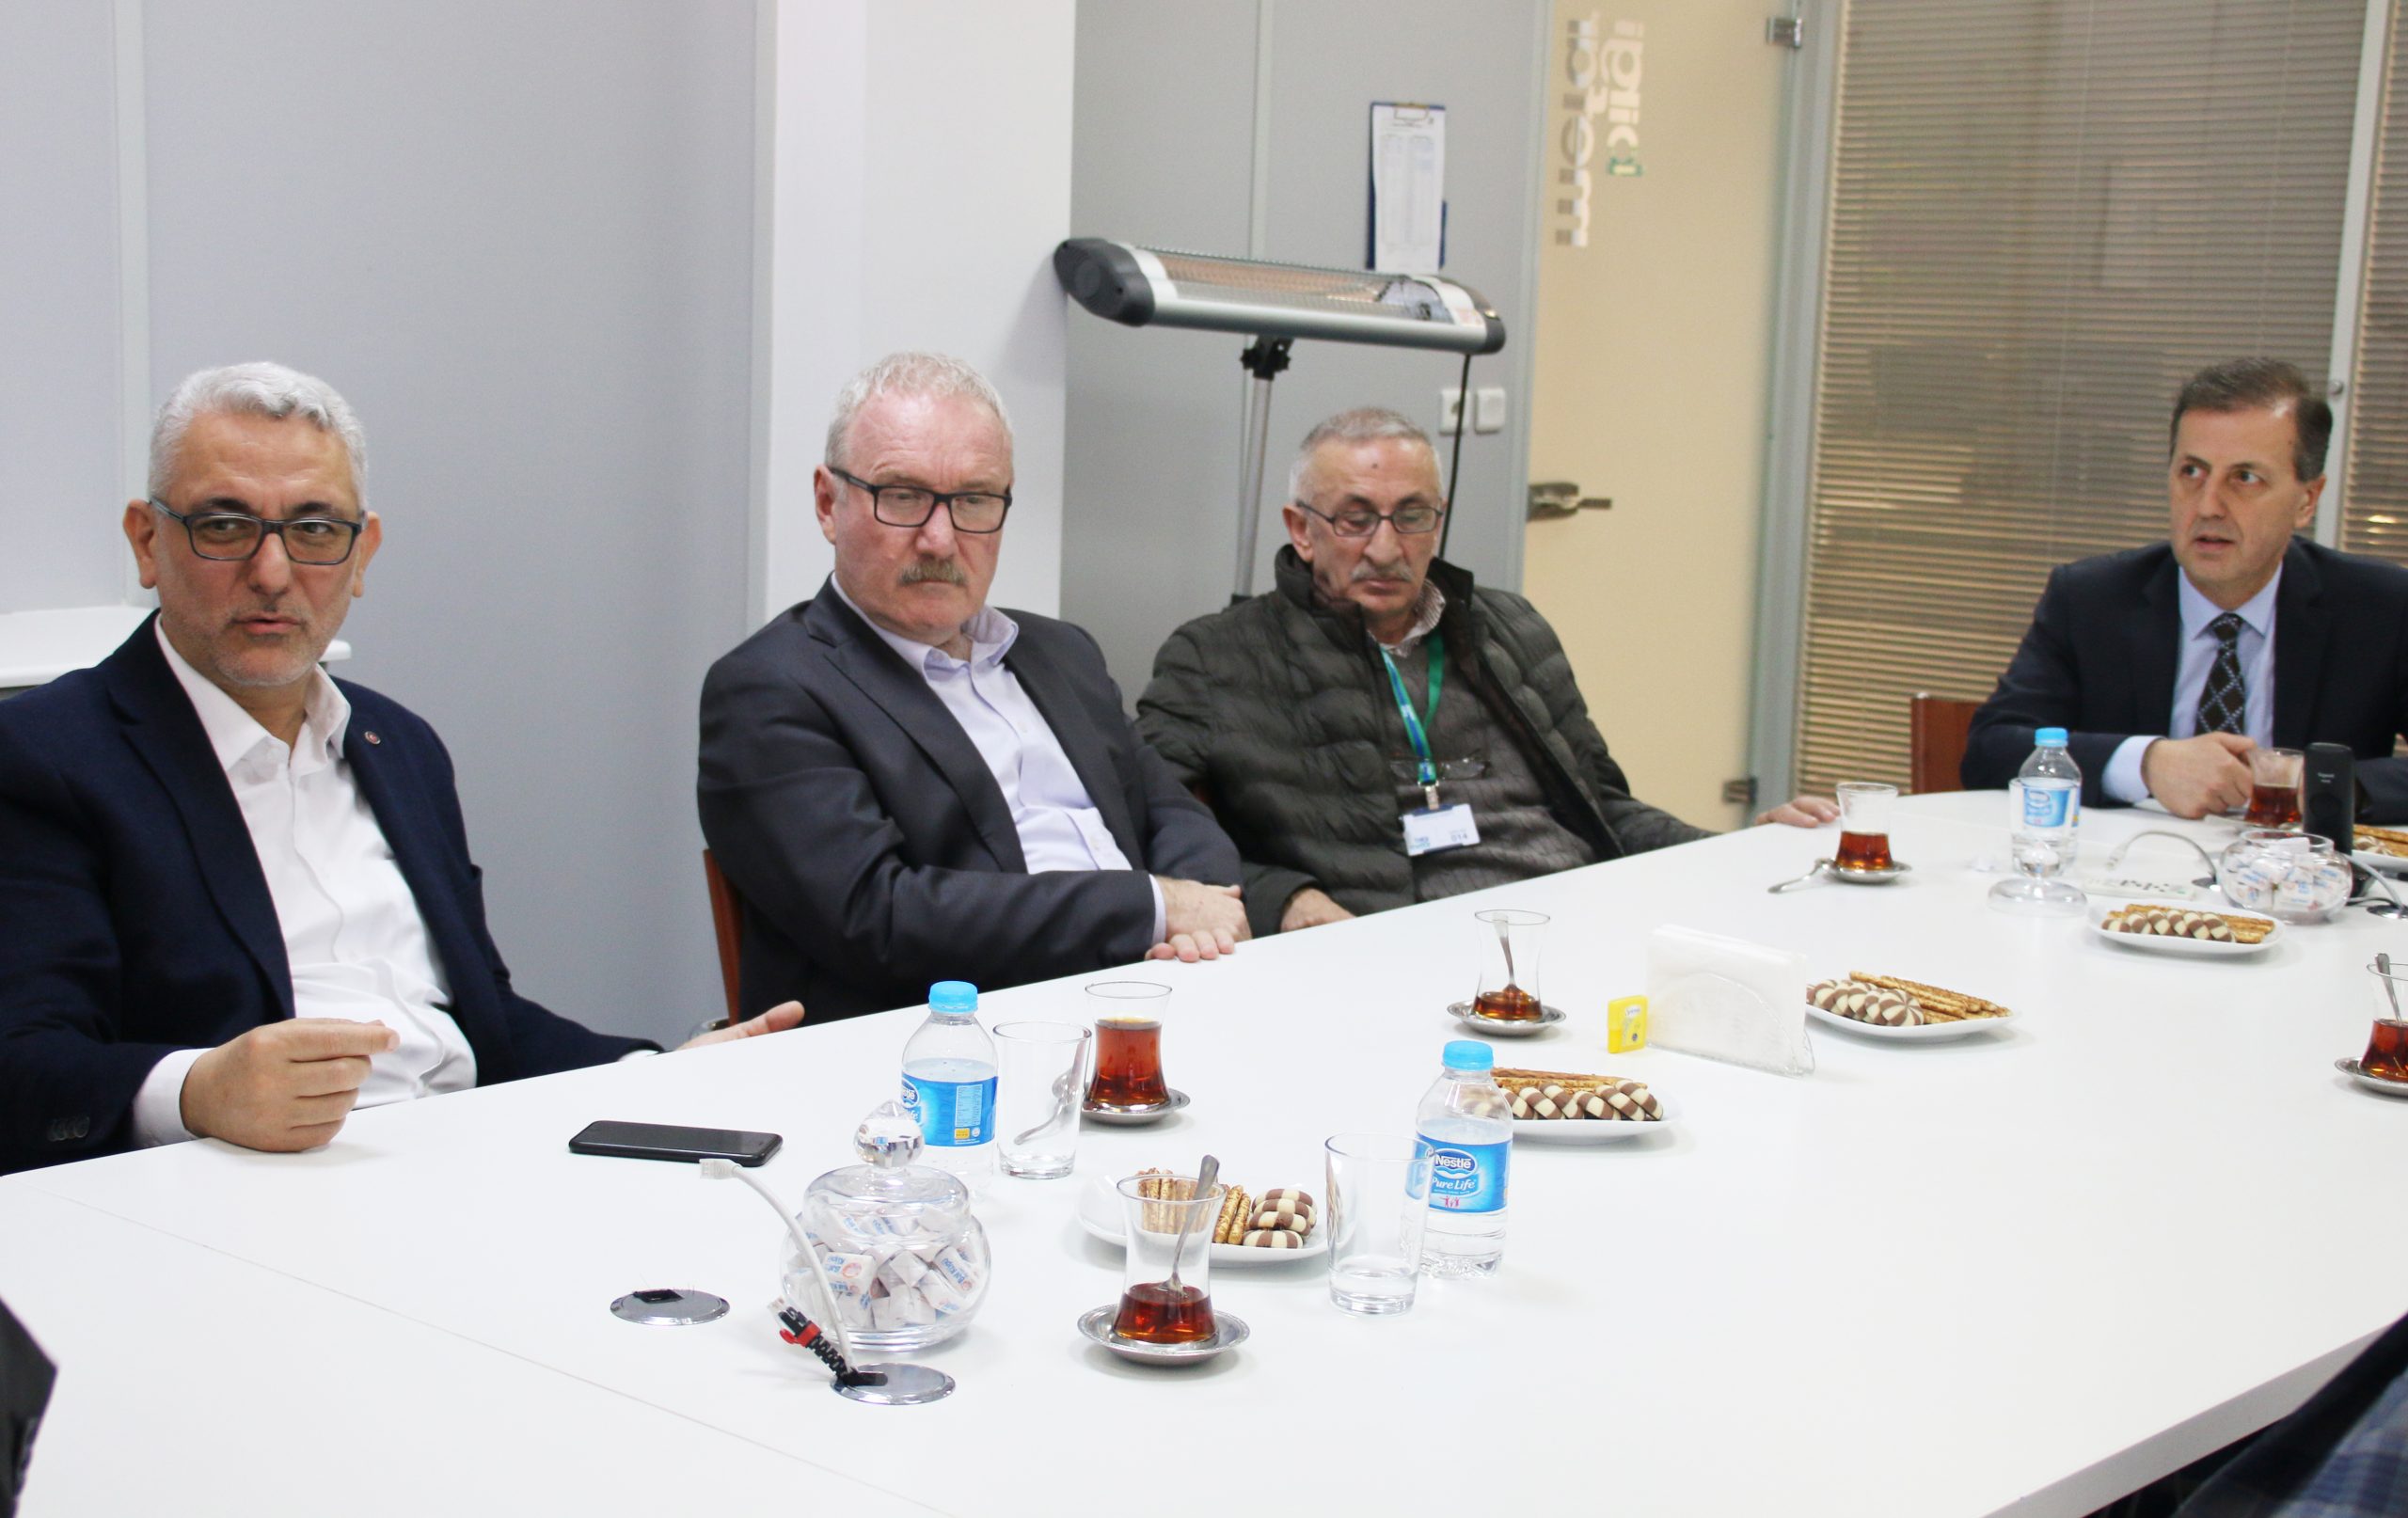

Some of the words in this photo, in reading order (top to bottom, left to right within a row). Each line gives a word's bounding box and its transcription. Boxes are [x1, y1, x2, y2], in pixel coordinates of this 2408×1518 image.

[1435, 1155, 1472, 1169] Nestlé
[1433, 1178, 1453, 1190] Pure
[1454, 1178, 1475, 1191] Life
